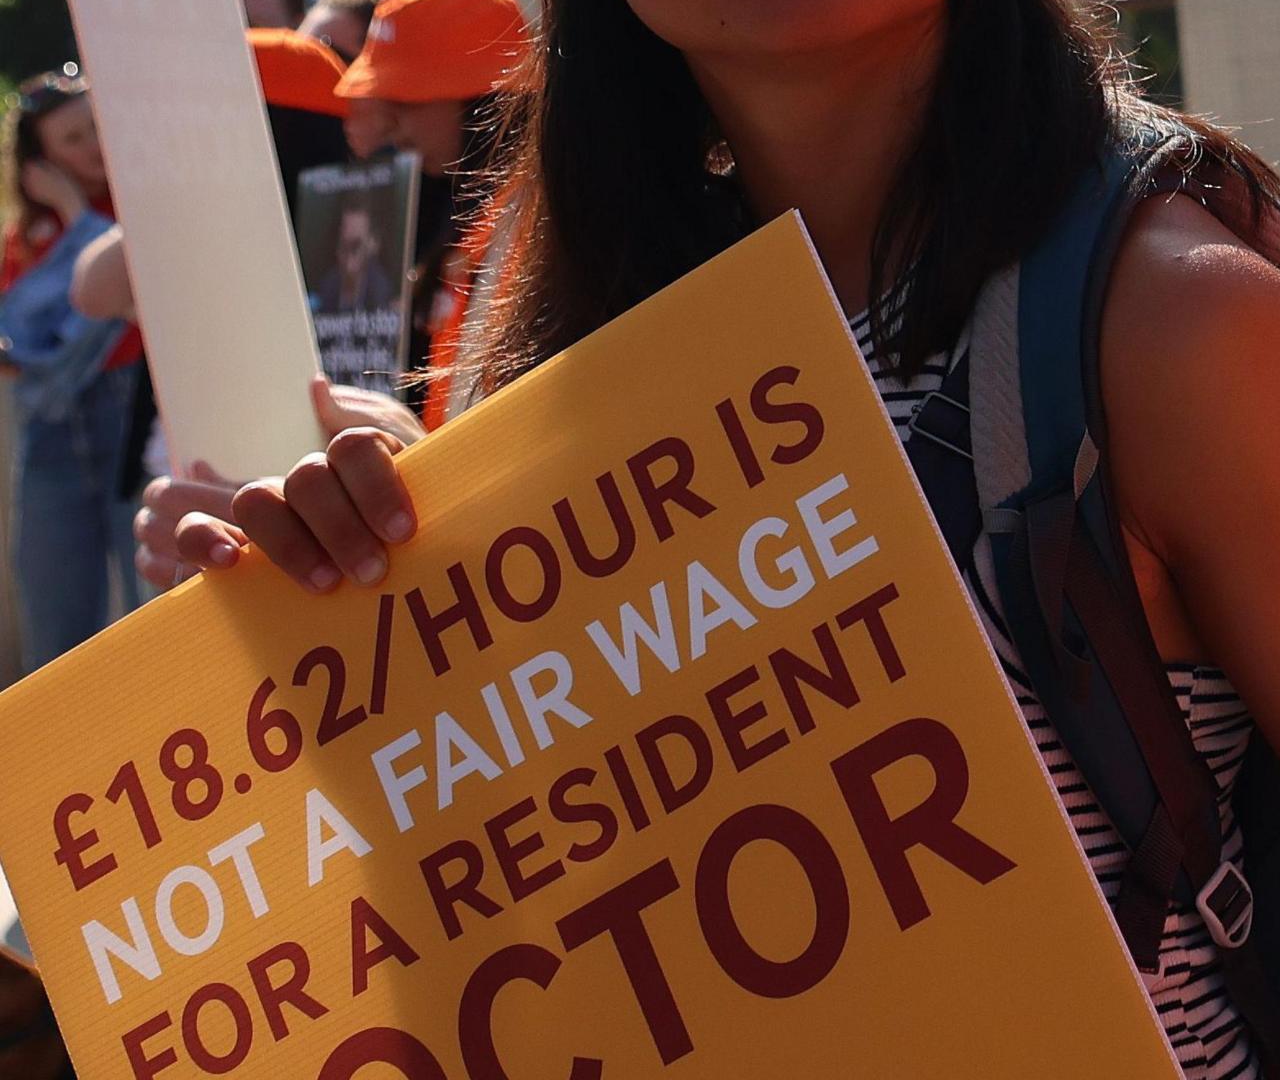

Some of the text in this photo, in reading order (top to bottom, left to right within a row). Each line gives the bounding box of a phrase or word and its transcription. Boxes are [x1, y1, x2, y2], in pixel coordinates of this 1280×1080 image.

[54, 365, 825, 891] £18.62/HOUR IS
[82, 474, 880, 1004] NOT A FAIR WAGE
[122, 583, 907, 1080] FOR A RESIDENT
[318, 718, 1018, 1080] CTOR
